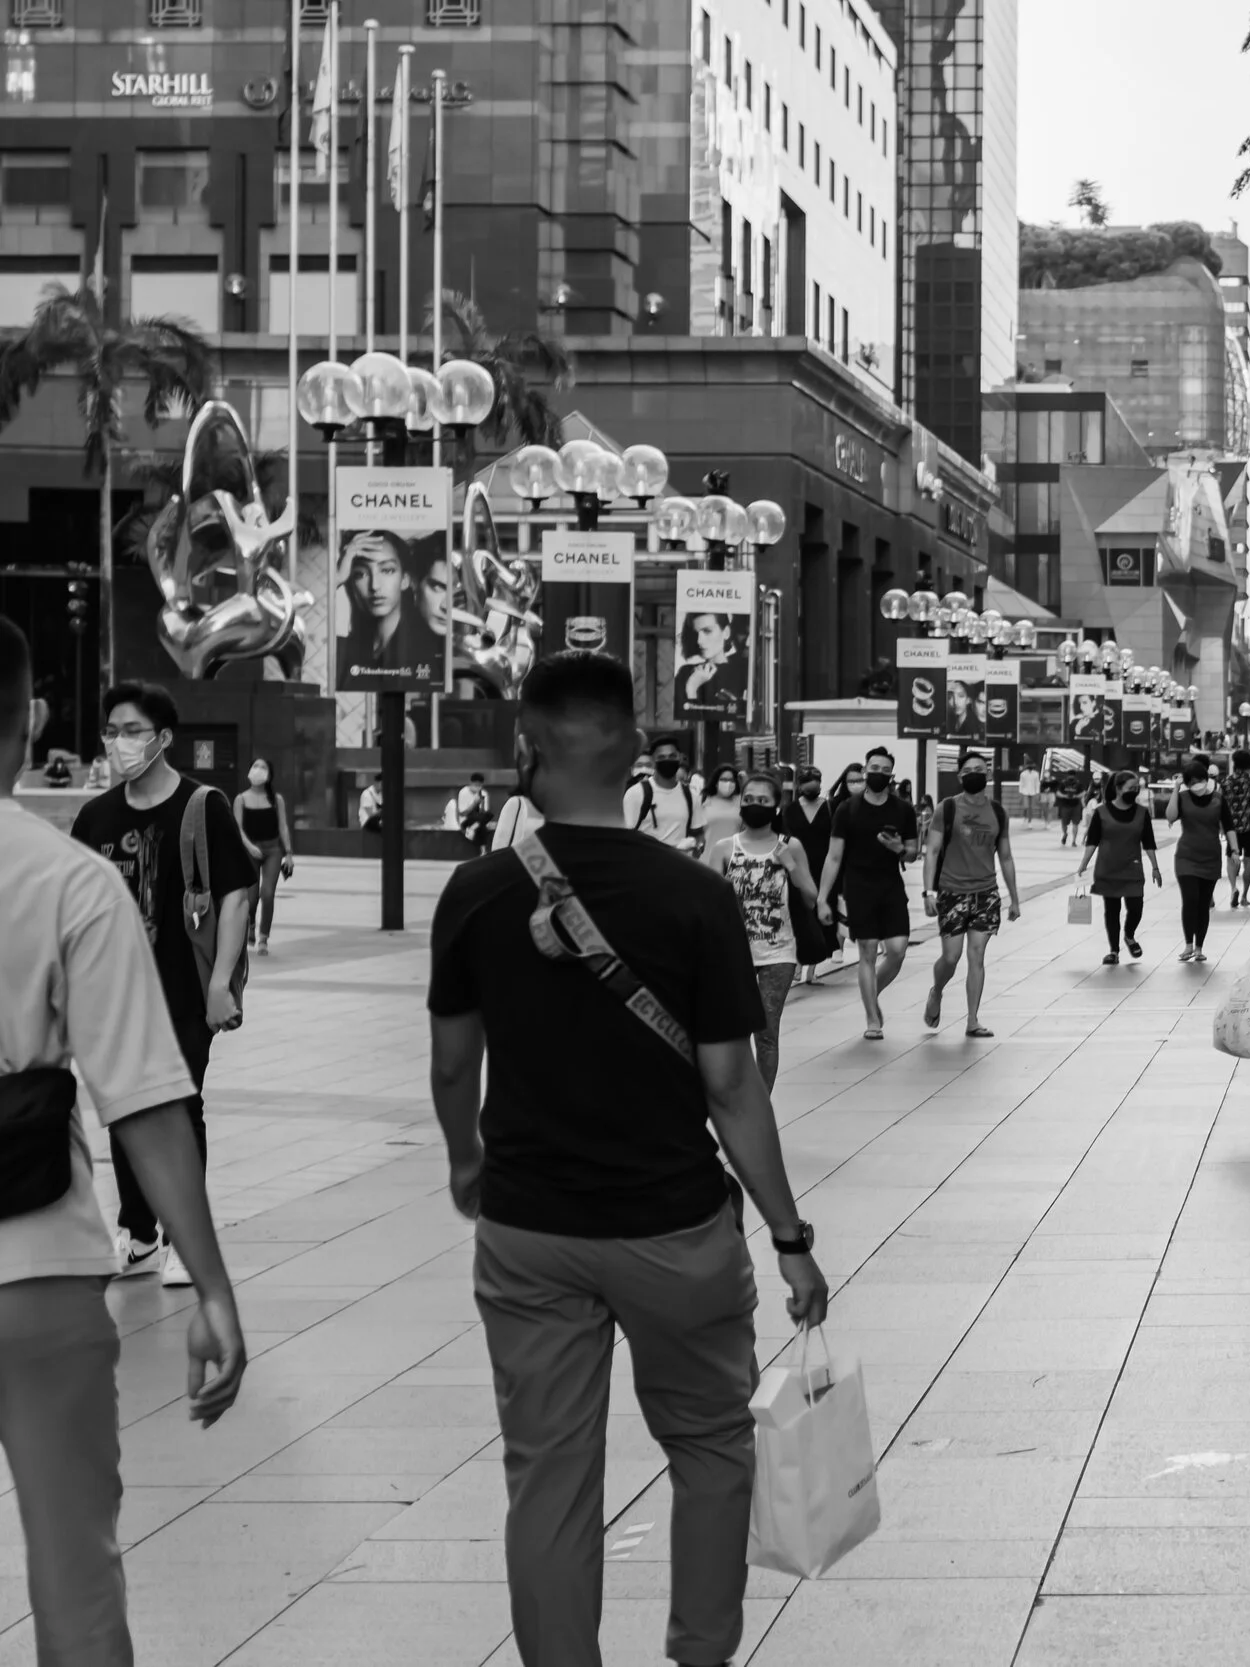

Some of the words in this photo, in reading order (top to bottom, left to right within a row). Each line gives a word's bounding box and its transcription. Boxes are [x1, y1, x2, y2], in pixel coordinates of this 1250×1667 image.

[112, 71, 213, 96] STARHILL
[350, 494, 433, 508] CHANEL
[553, 552, 621, 565] CHANEL
[686, 588, 742, 600] CHANEL
[903, 650, 942, 658] CHANEL
